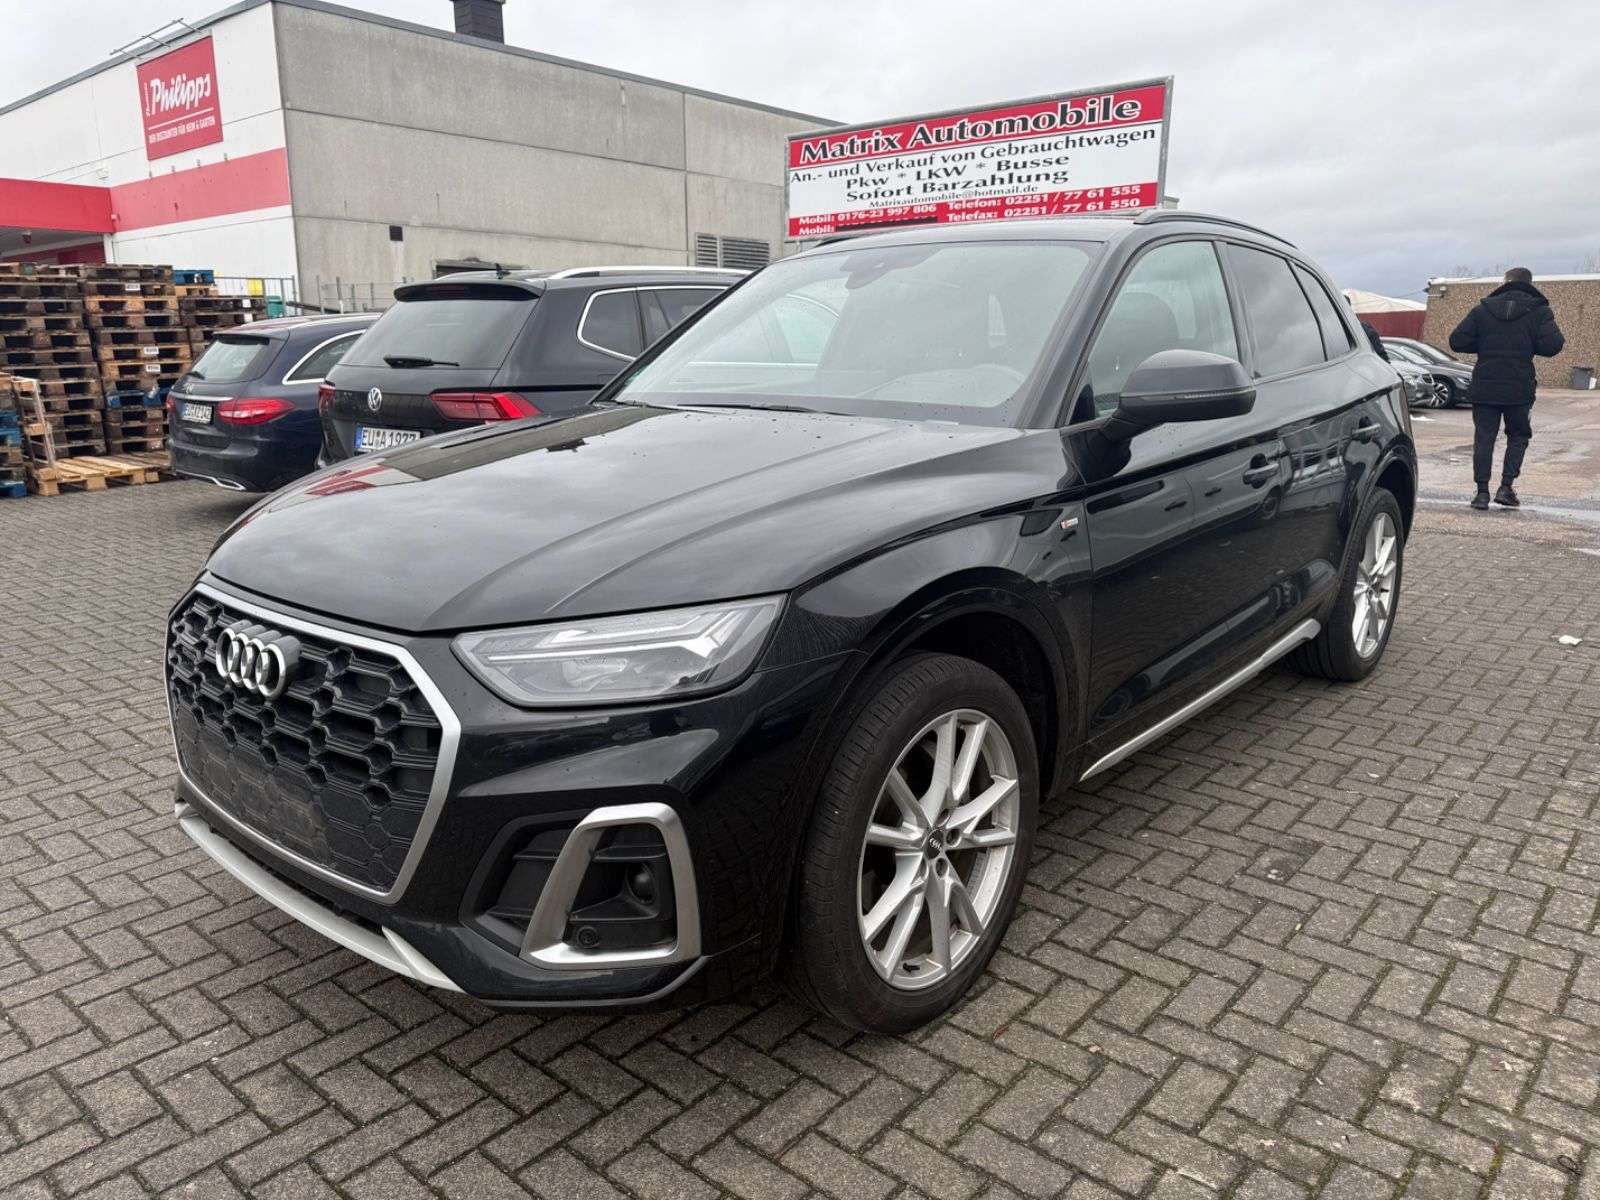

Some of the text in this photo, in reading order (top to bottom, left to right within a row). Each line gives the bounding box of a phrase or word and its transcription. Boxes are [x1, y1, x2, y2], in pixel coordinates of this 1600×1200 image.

[150, 73, 211, 115] Philipps
[800, 95, 1141, 163] Matrix Automobile
[828, 163, 860, 178] und
[866, 152, 936, 171] Verkauf
[941, 148, 976, 163] von
[980, 129, 1156, 159] Gebrauchtwagen
[846, 155, 1070, 190] Pkw LKW Busse
[847, 170, 1070, 202] Sofort Barzahlung
[947, 198, 1001, 211] Telefon:
[1005, 194, 1049, 206] 02251
[1064, 190, 1085, 200] 77
[1111, 185, 1141, 196] 555
[947, 210, 998, 222] Telefax:
[1004, 206, 1047, 217] 02251
[1063, 203, 1081, 213] 77
[1110, 198, 1141, 208] 550
[799, 213, 835, 224] Mobil:
[837, 209, 884, 221] 0176-23
[887, 206, 911, 216] 997
[799, 225, 835, 235] Mobil:
